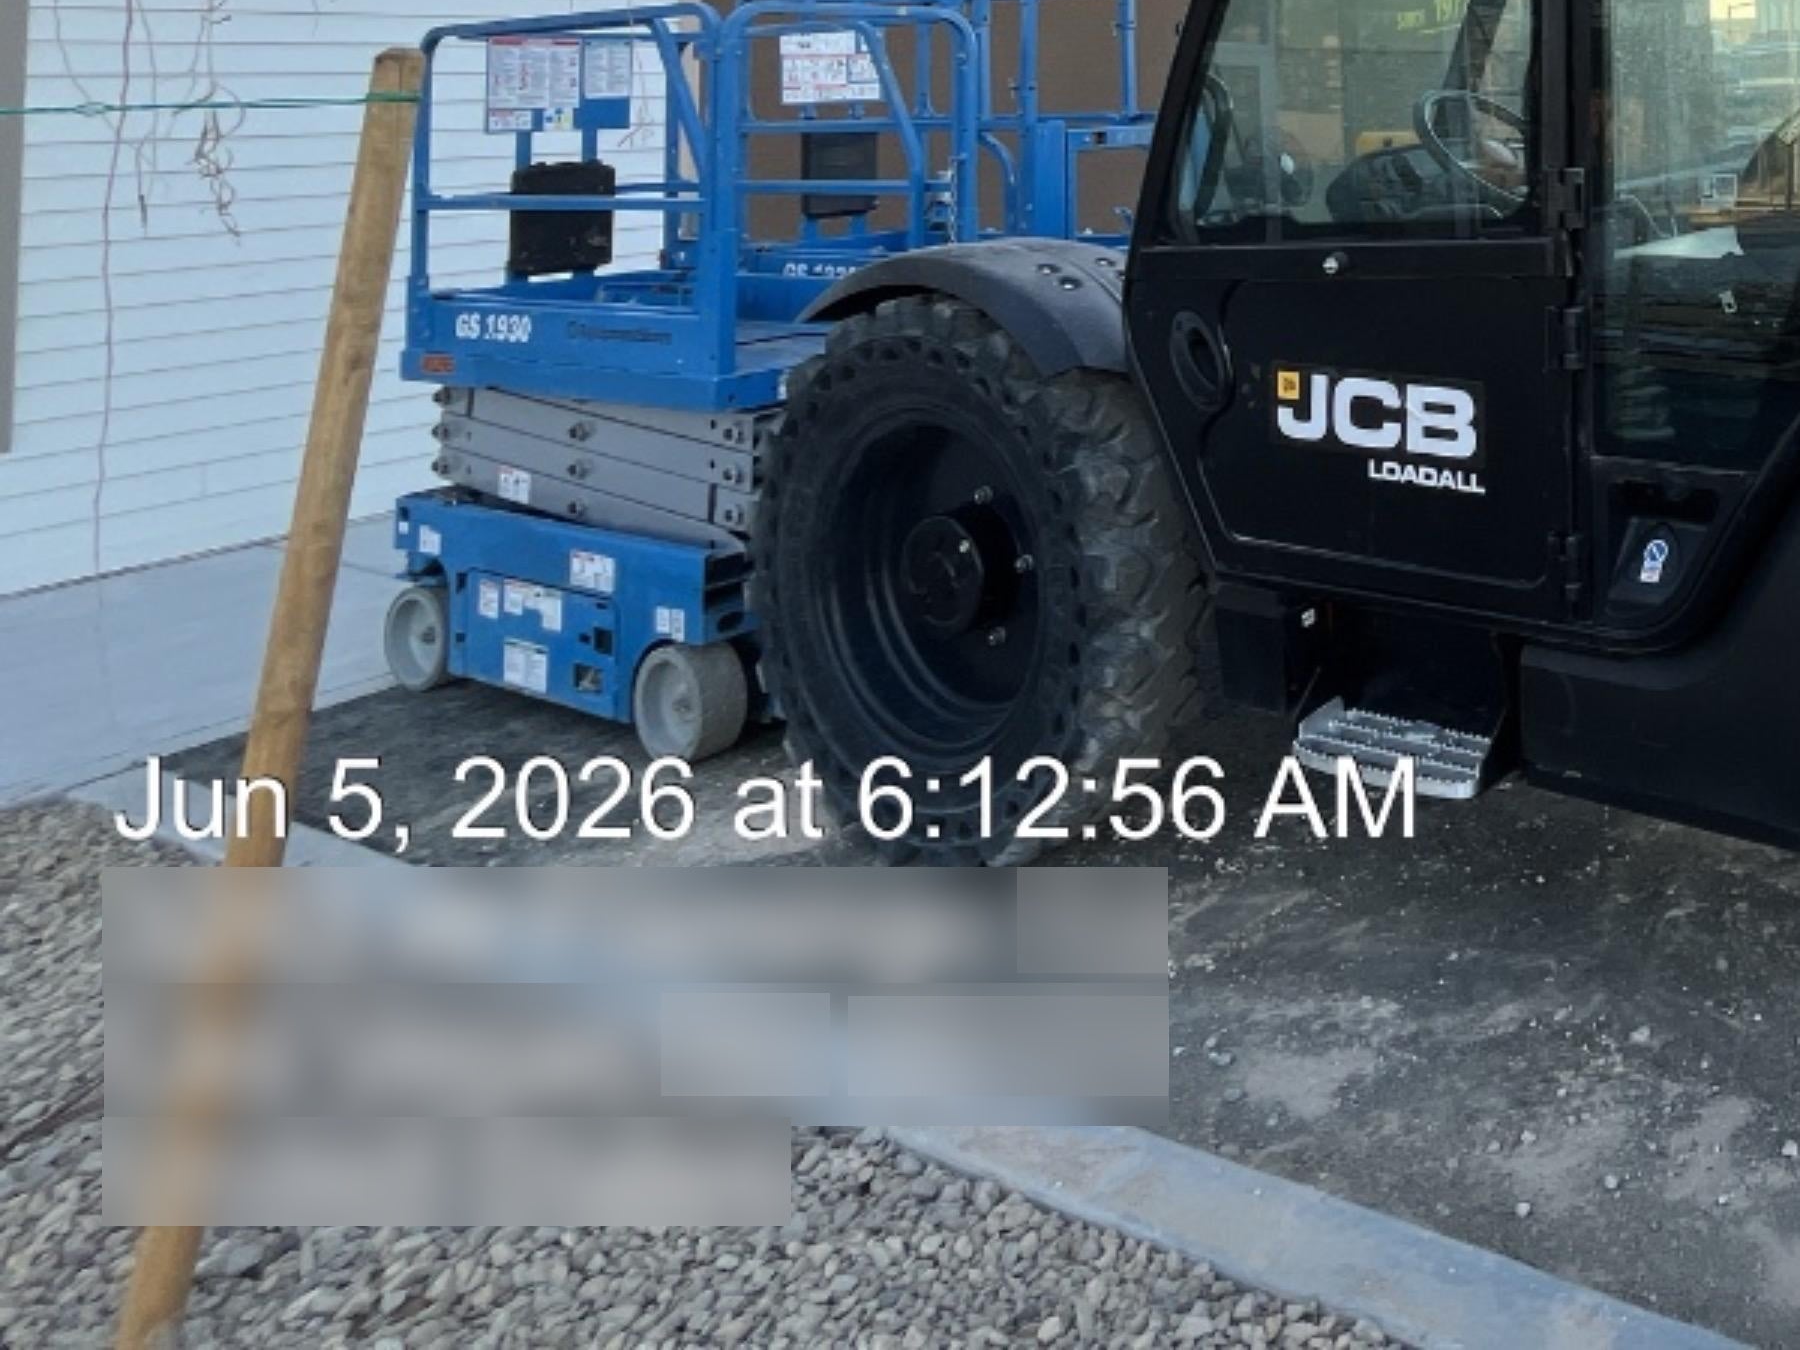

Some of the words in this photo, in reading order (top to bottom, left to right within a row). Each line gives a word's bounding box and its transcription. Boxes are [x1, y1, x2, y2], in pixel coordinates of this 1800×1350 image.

[456, 311, 481, 340] GS
[484, 314, 532, 343] 1930
[1276, 374, 1477, 458] JCB
[1367, 457, 1487, 495] LOADALL
